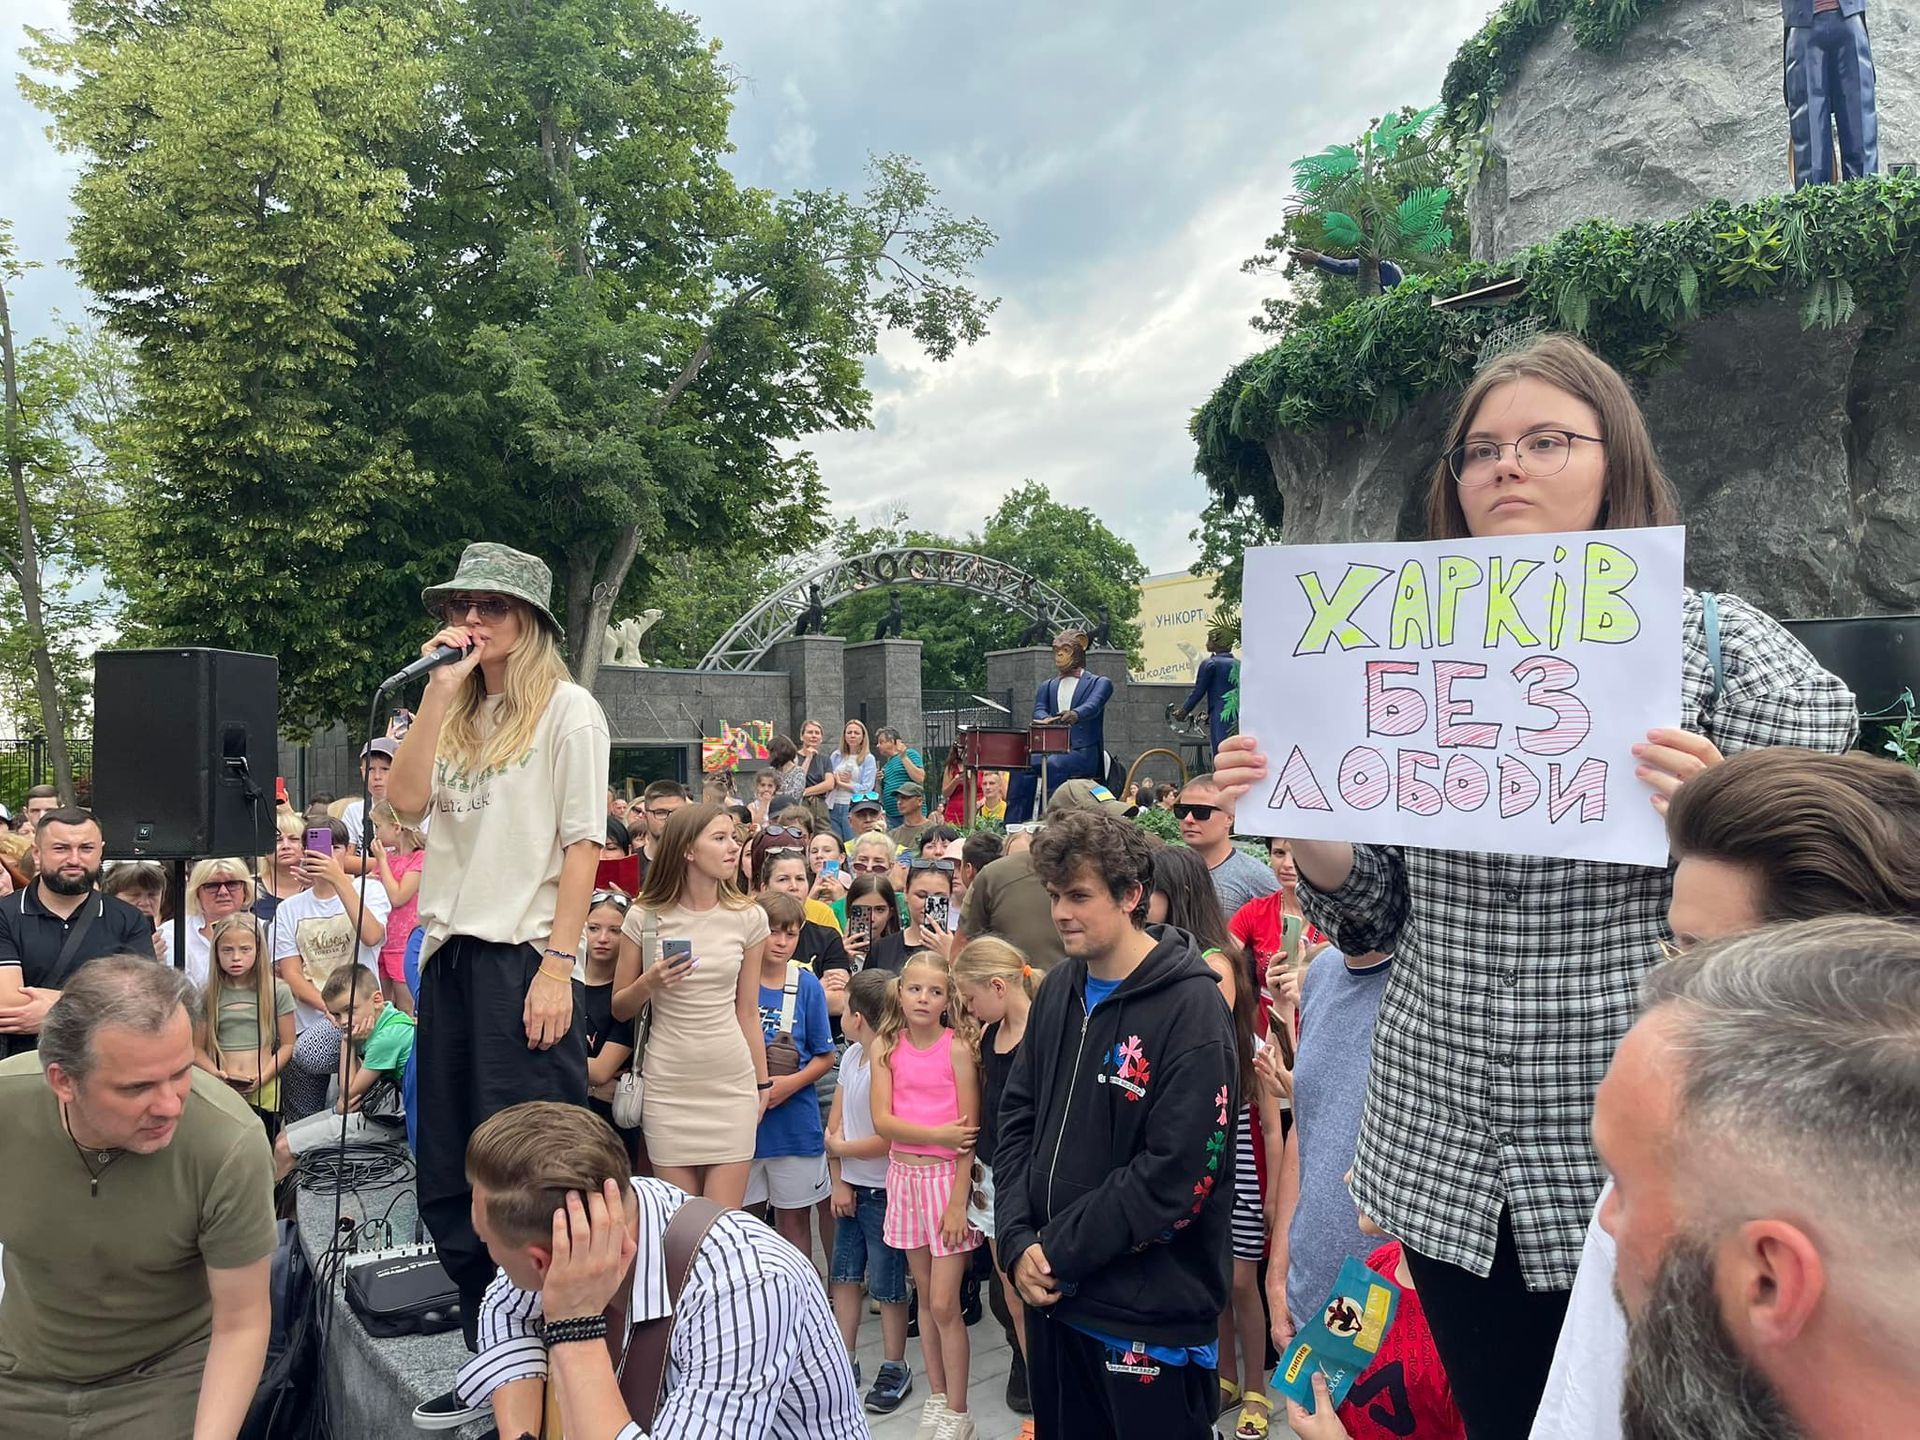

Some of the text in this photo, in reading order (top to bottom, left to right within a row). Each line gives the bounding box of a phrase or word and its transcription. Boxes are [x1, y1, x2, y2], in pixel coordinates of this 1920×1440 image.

[850, 551, 1037, 602] ЗООПАРК
[1365, 655, 1591, 756] БЕЗ
[1268, 745, 1609, 824] ЛОБОДИ
[1290, 1346, 1308, 1374] ЛИПНЯ
[1328, 1368, 1345, 1395] OLSKY
